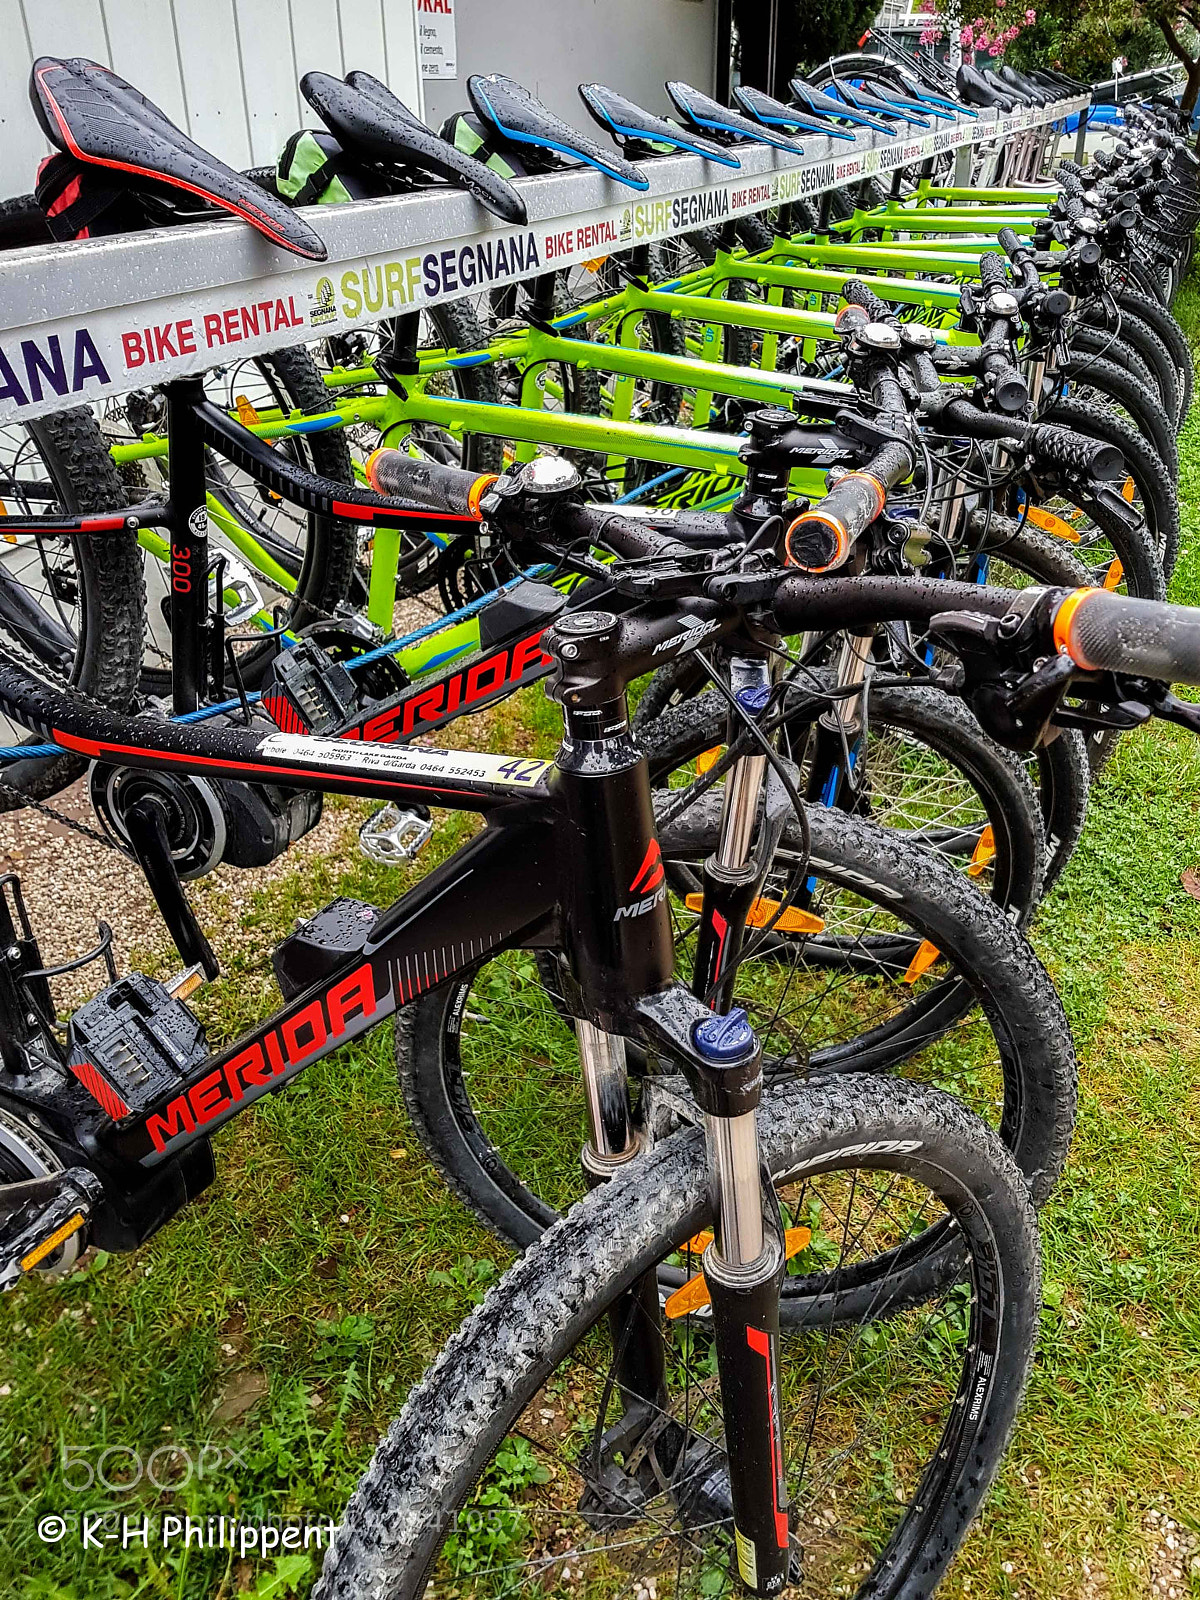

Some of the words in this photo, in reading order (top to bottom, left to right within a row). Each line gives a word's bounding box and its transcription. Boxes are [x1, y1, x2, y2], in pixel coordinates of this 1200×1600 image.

[238, 198, 287, 232] MERIDA
[732, 190, 747, 209] BIKE
[748, 184, 771, 204] RENTAL
[545, 231, 574, 259] BIKE
[577, 221, 618, 251] RENTAL
[121, 319, 197, 369] BIKE
[203, 295, 304, 349] RENTAL
[789, 447, 850, 455] MERIDA
[172, 544, 192, 593] 300
[651, 618, 717, 656] MERIDA
[340, 625, 555, 745] ERIDA
[361, 756, 380, 765] Riva
[383, 757, 417, 770] d/Garda
[420, 762, 445, 773] 0464
[448, 765, 486, 778] 552453
[497, 759, 545, 782] 42
[146, 962, 378, 1154] MERIDA
[968, 1376, 987, 1421] ALEXRIMS
